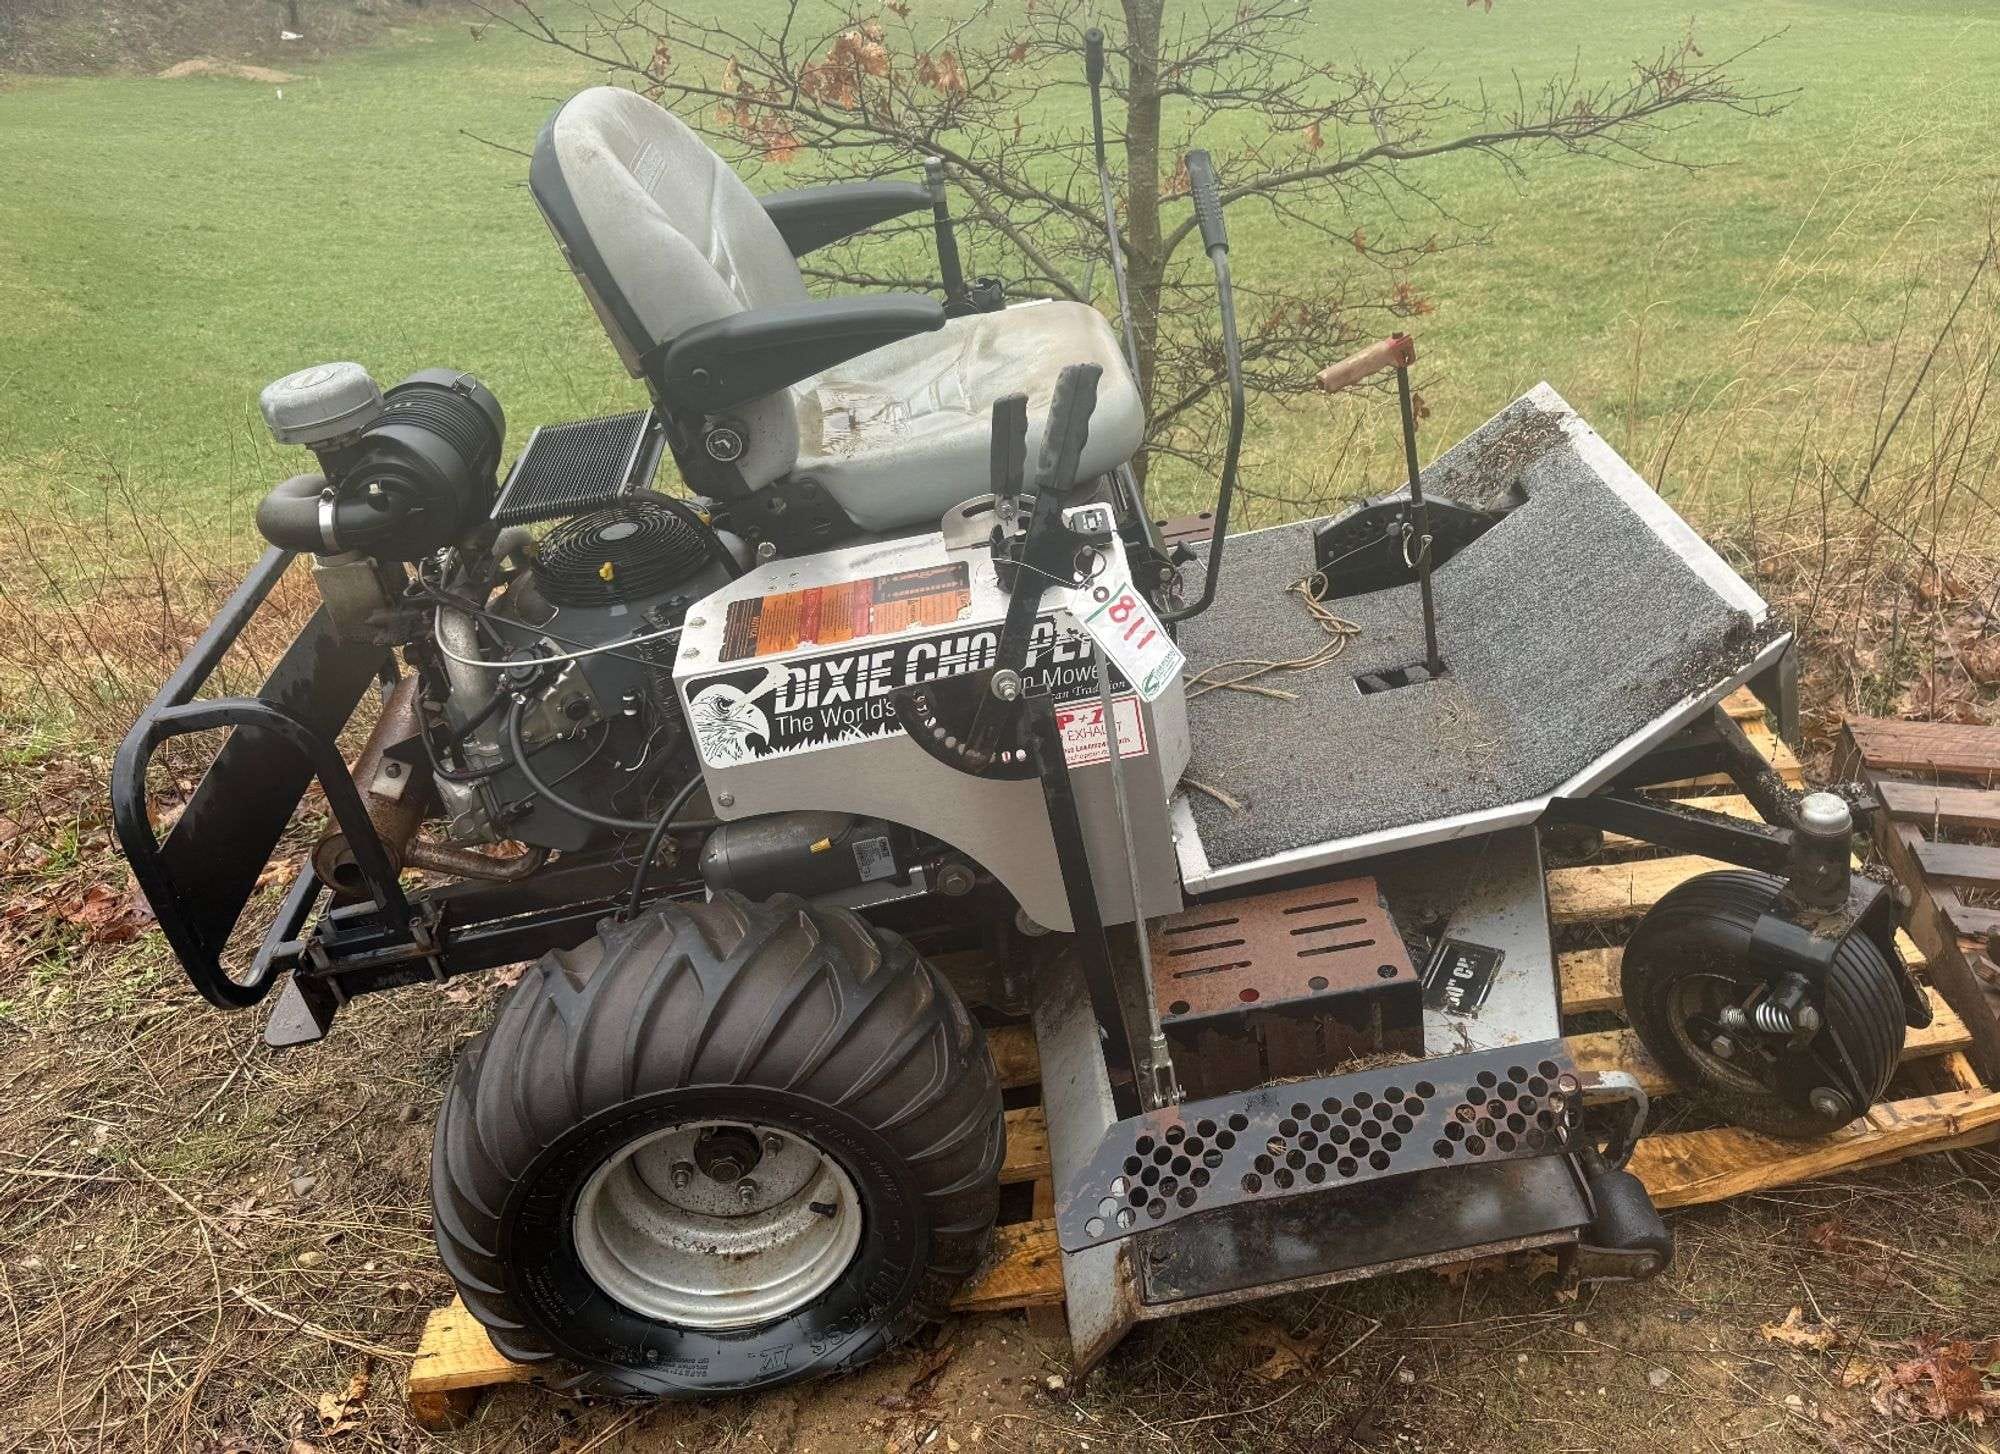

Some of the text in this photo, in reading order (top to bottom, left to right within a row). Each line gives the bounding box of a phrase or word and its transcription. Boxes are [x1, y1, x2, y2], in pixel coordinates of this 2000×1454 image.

[1108, 595, 1156, 650] 811
[774, 649, 894, 714] DIXIE
[905, 622, 1092, 685] CHOPE
[776, 715, 814, 737] The
[821, 698, 896, 728] World's
